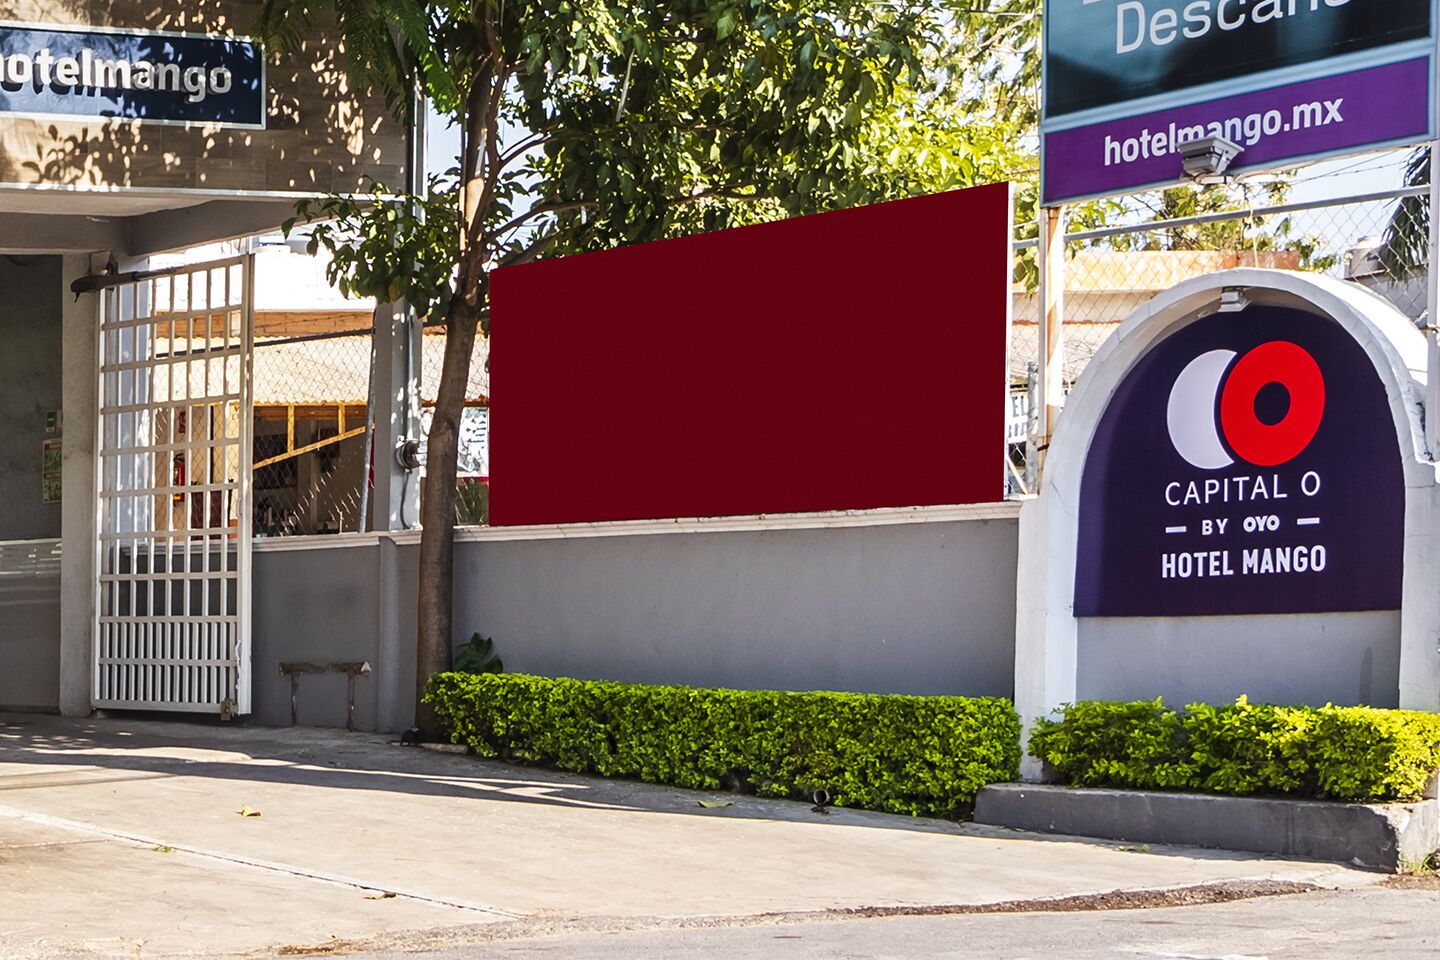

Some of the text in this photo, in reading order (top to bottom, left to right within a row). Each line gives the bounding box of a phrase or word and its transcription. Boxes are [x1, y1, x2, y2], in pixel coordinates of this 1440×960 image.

[1104, 97, 1344, 166] hotelmango.mx
[1165, 471, 1321, 506] CAPITAL O
[1202, 514, 1280, 536] BY OYO
[1162, 544, 1327, 579] HOTEL MANGO
